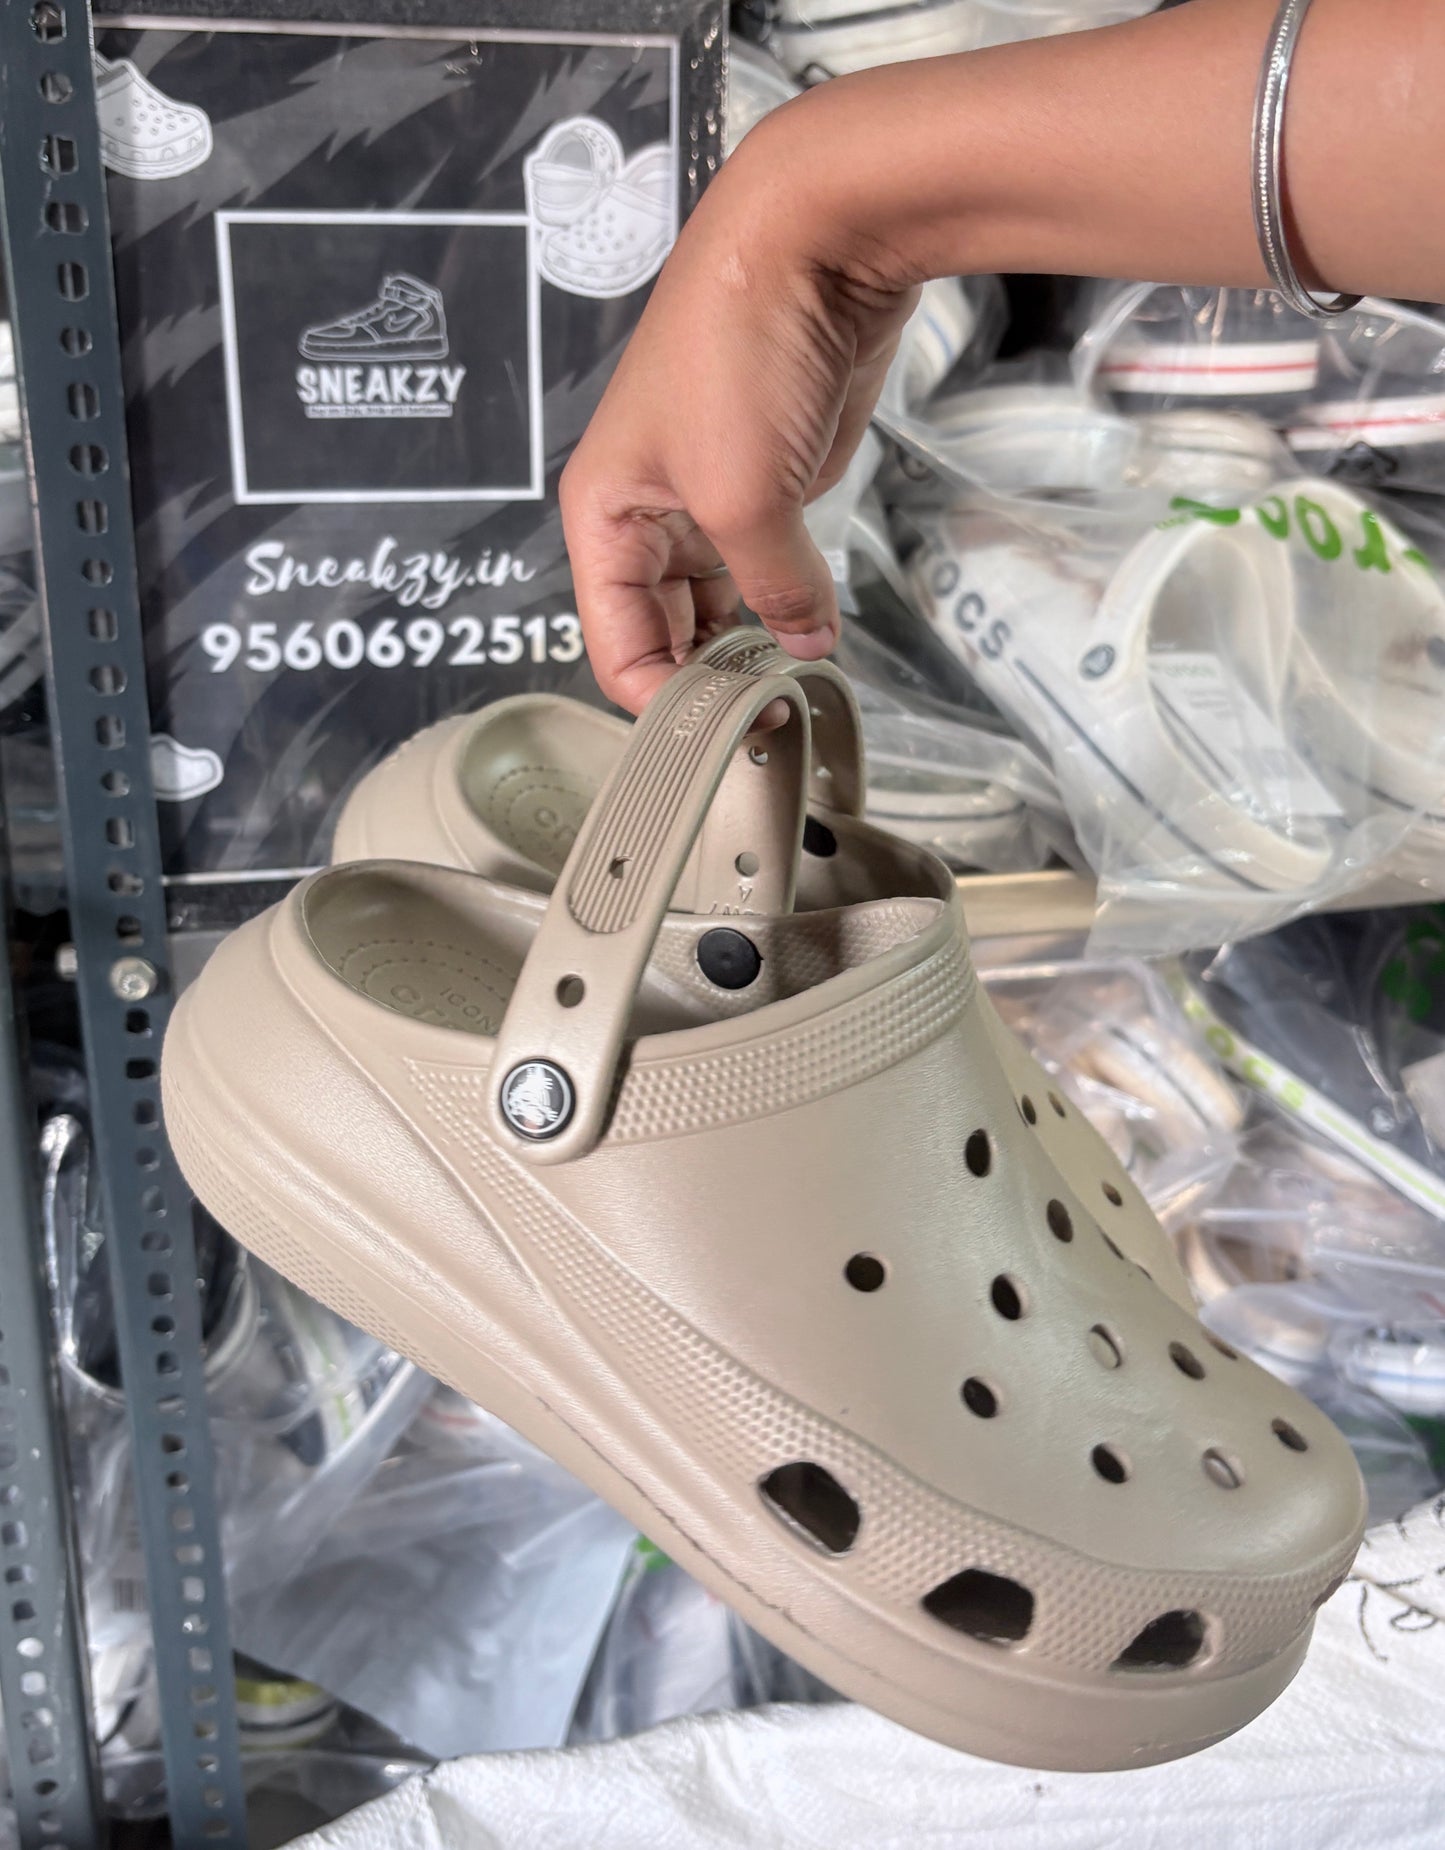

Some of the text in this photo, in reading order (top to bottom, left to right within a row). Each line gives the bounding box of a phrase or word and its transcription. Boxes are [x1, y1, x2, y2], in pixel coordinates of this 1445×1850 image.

[297, 366, 466, 403] SNEAKZY
[245, 536, 536, 609] Sneakzy.in
[201, 613, 585, 673] 9560692513
